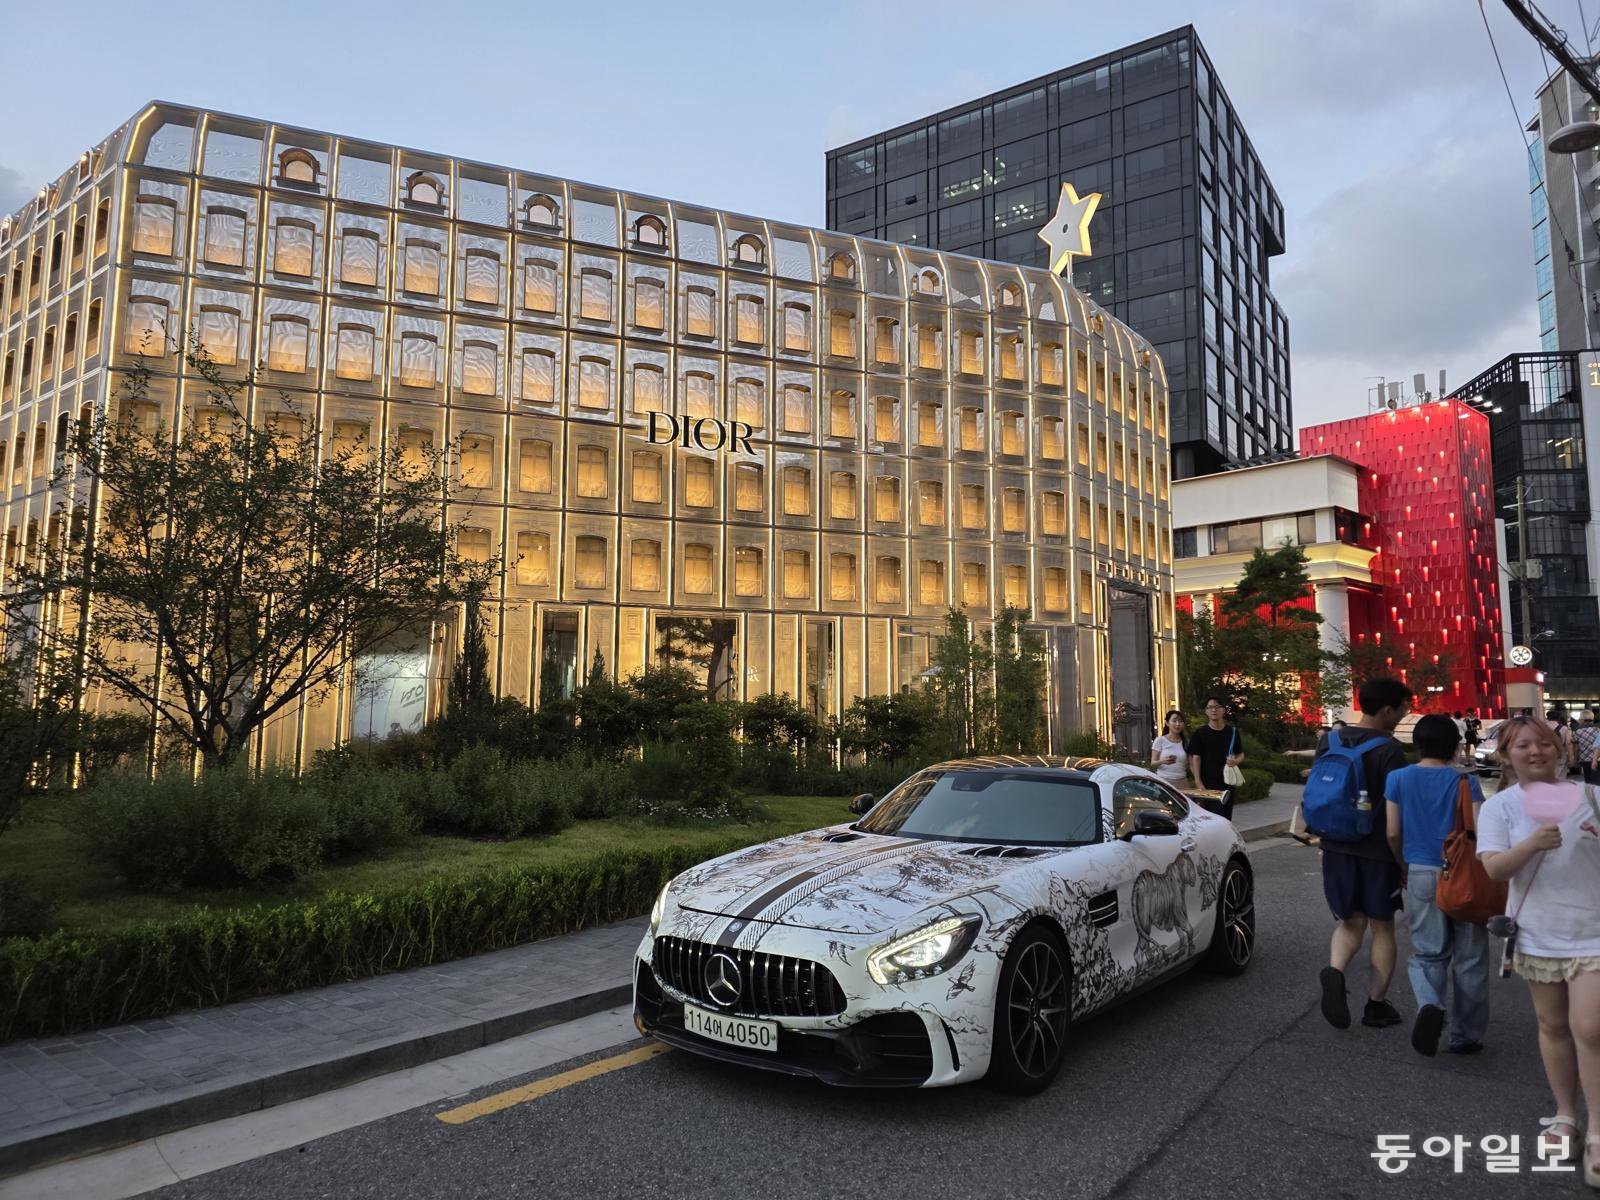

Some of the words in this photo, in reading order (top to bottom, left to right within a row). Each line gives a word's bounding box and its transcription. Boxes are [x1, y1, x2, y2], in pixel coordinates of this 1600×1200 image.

[645, 410, 758, 456] DIOR
[689, 1010, 723, 1038] 114어
[726, 1022, 770, 1047] 4050
